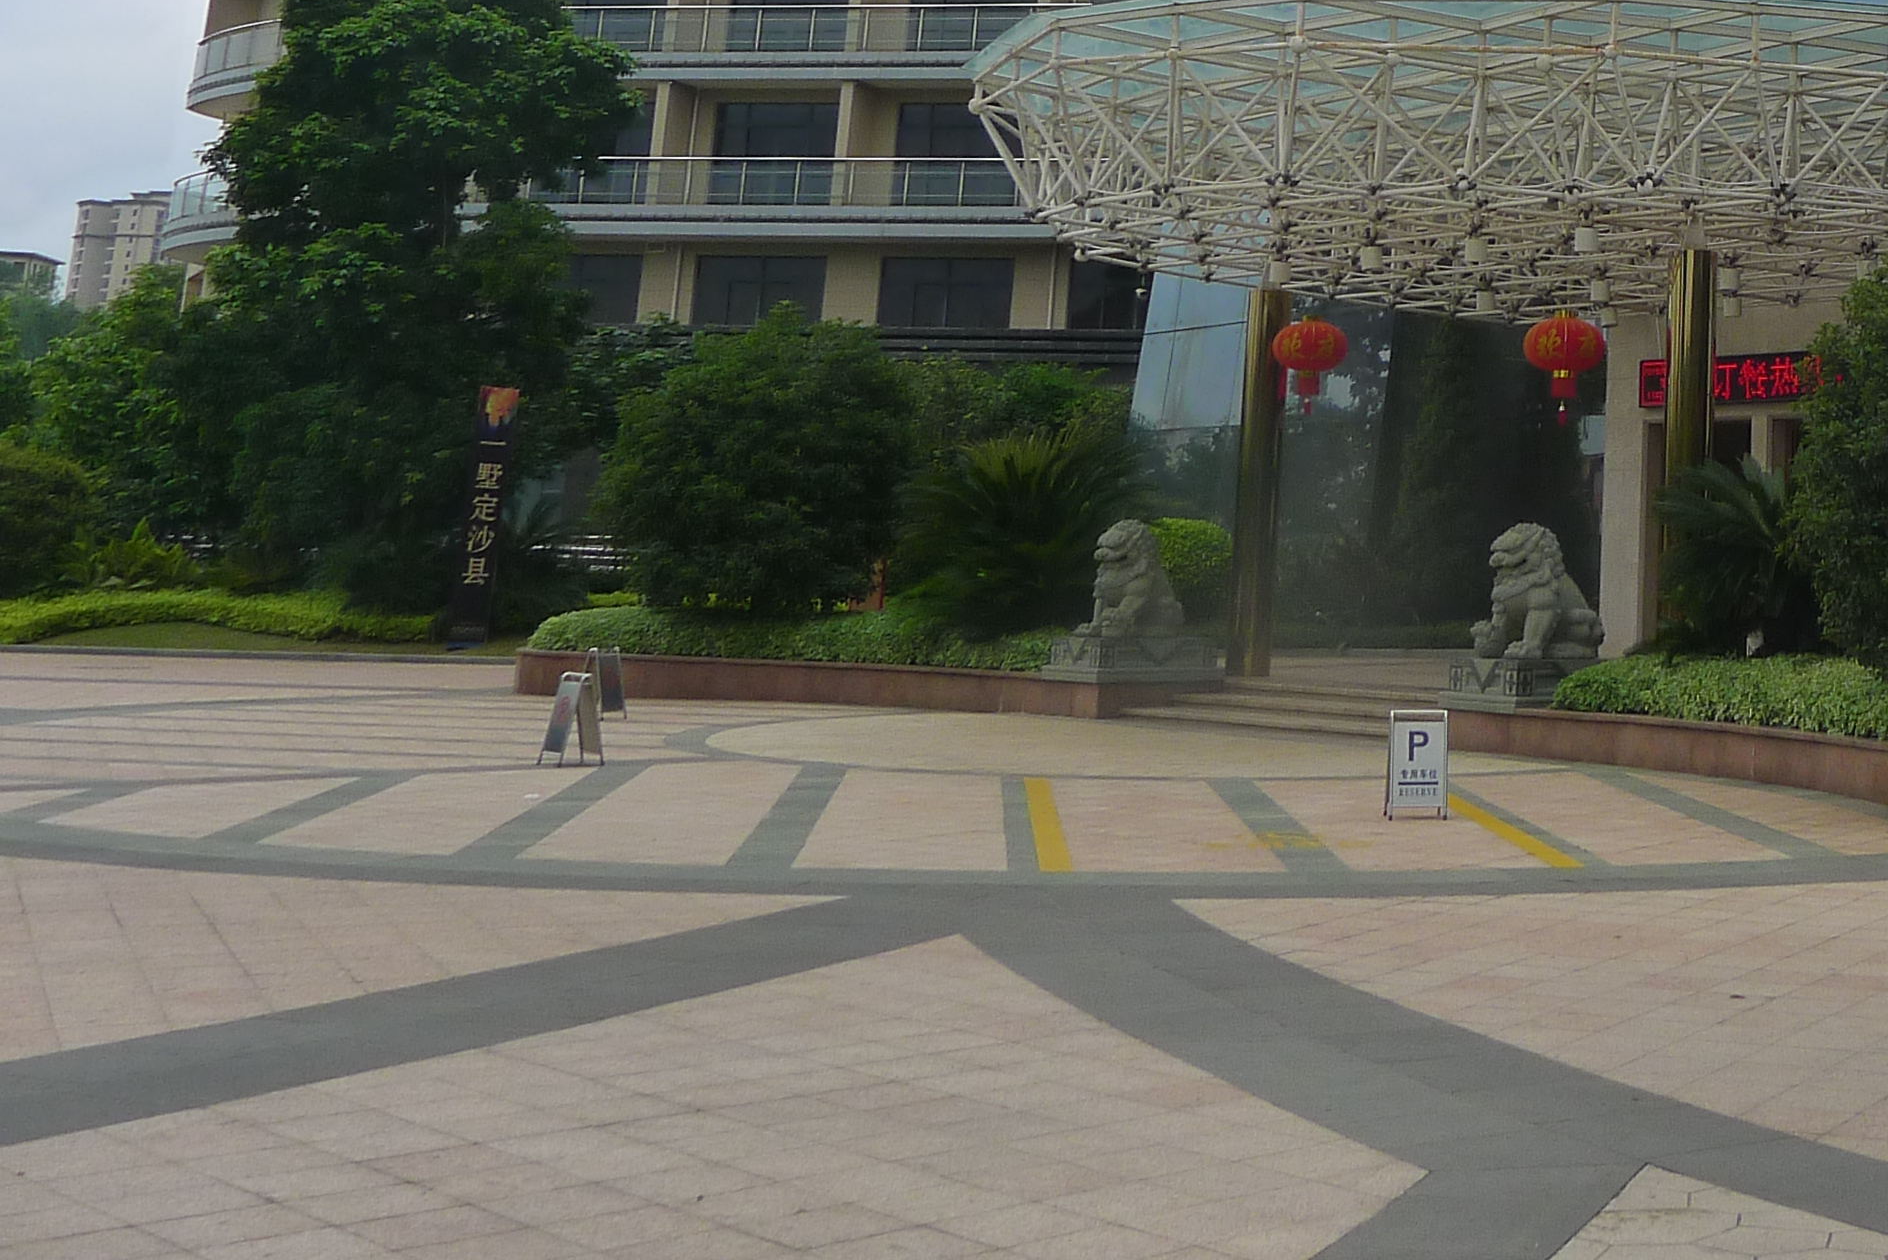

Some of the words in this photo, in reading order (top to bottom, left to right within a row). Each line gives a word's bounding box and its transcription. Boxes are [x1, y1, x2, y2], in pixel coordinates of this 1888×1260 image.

[461, 439, 508, 586] 一墅定沙县
[1408, 730, 1430, 762] P
